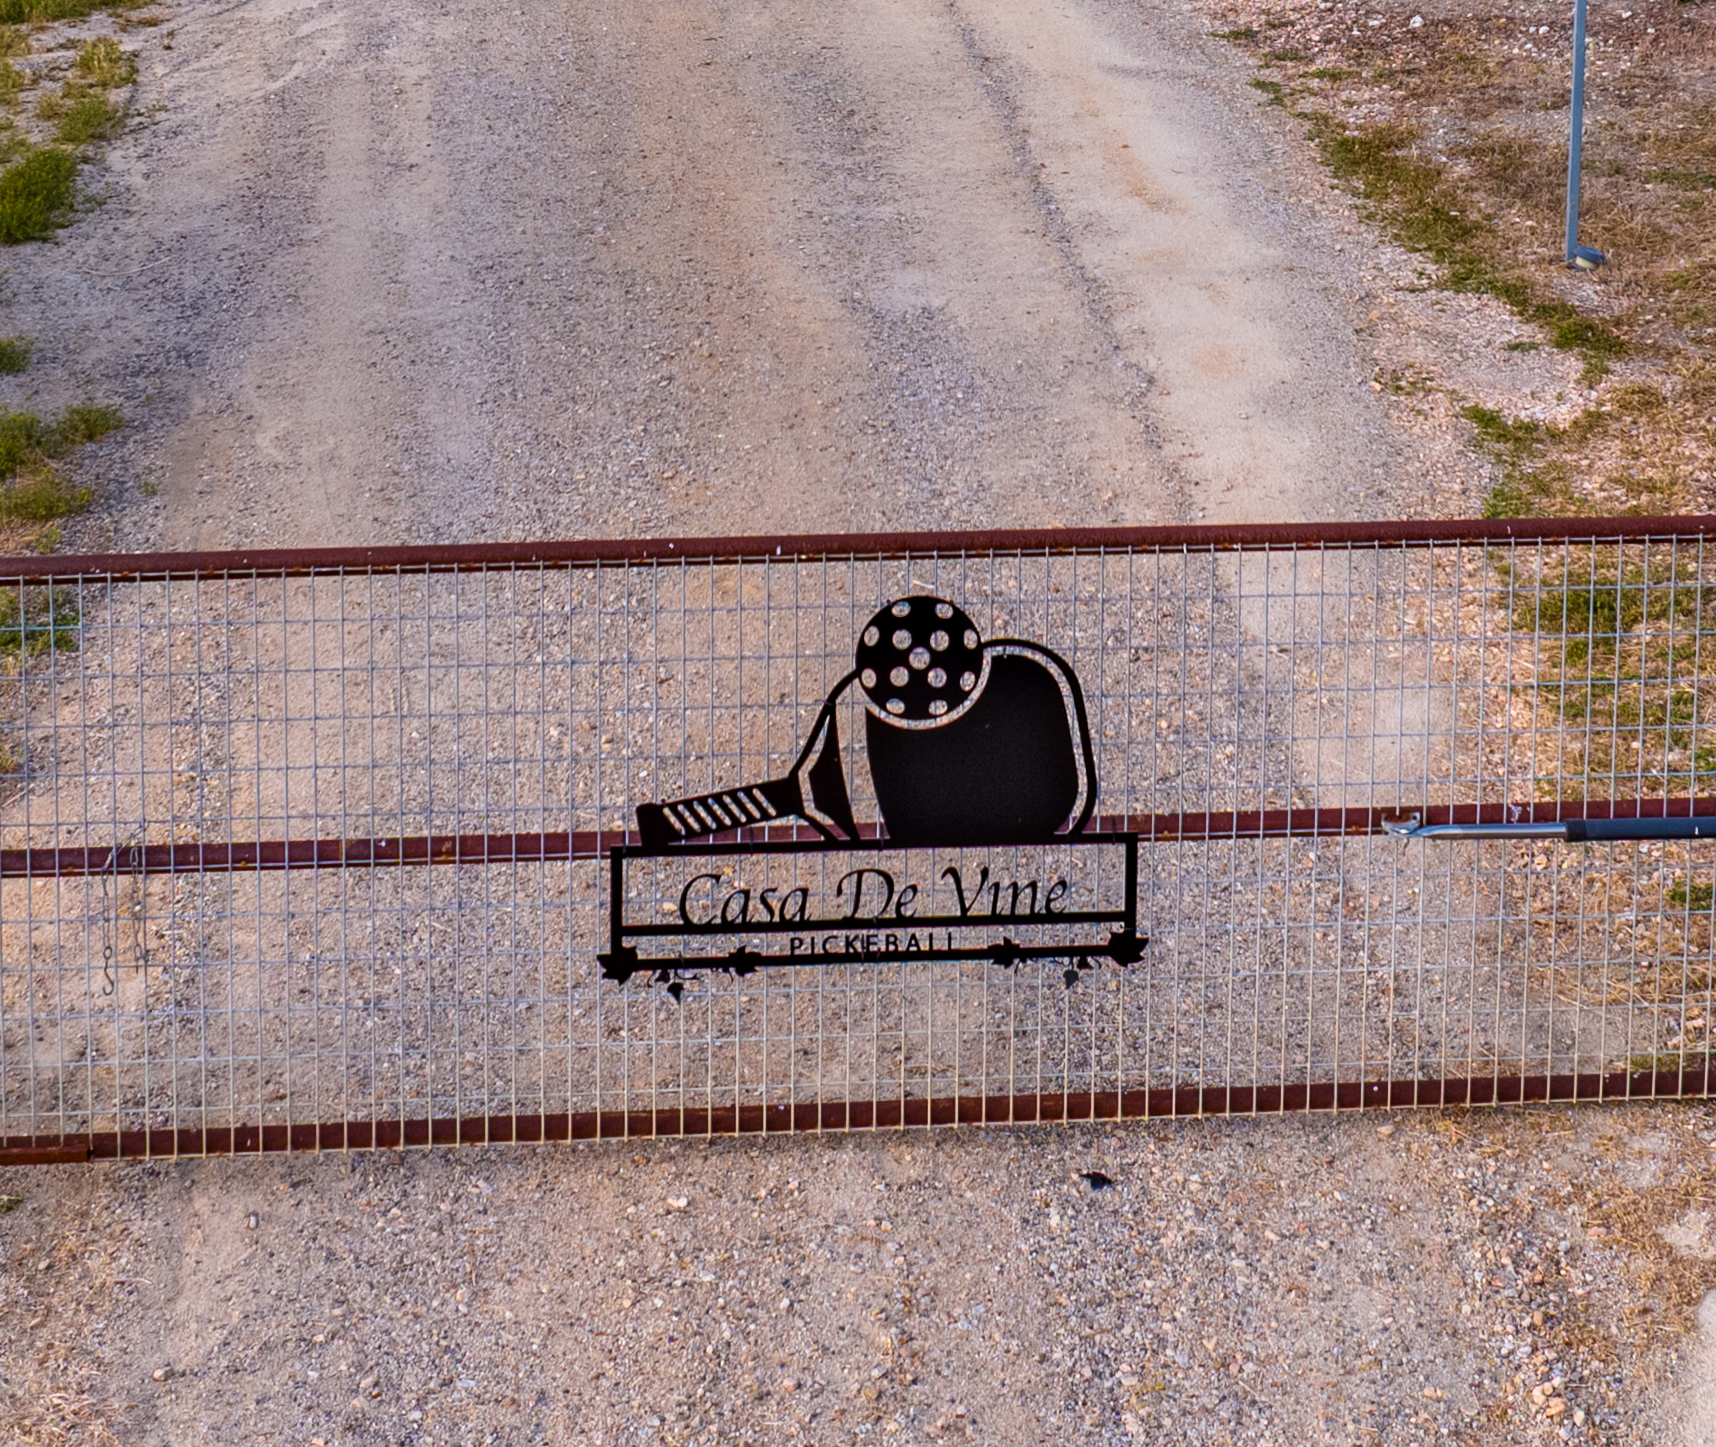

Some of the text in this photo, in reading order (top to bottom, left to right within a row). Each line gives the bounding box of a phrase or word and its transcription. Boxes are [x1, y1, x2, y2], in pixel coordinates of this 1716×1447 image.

[679, 866, 1068, 926] Casa De Vine
